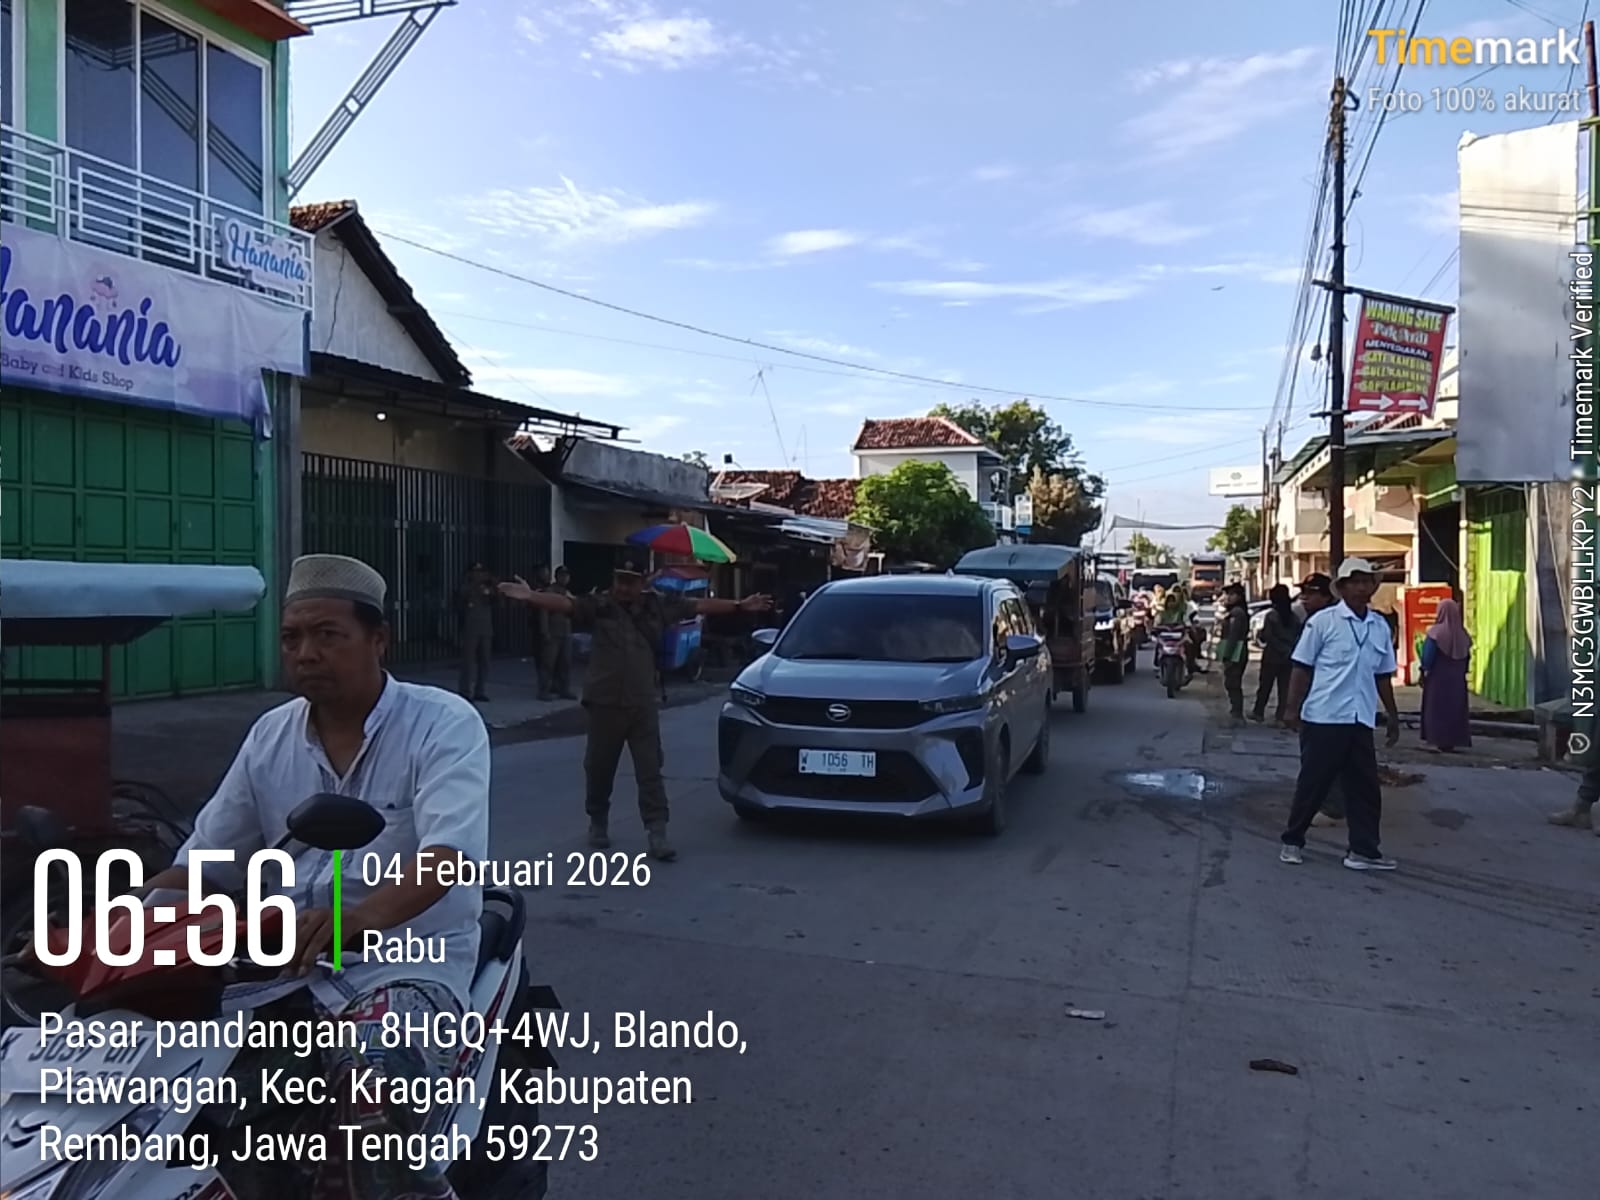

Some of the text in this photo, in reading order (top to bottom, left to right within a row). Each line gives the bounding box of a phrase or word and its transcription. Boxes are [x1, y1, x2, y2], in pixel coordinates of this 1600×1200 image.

[228, 222, 306, 281] Hanania
[1366, 298, 1443, 332] WARUNG SATE
[1365, 339, 1429, 359] MENYEDIAKAN
[0, 352, 135, 391] Baby ad Kids Shop
[822, 752, 848, 768] 1056
[861, 754, 874, 768] TH
